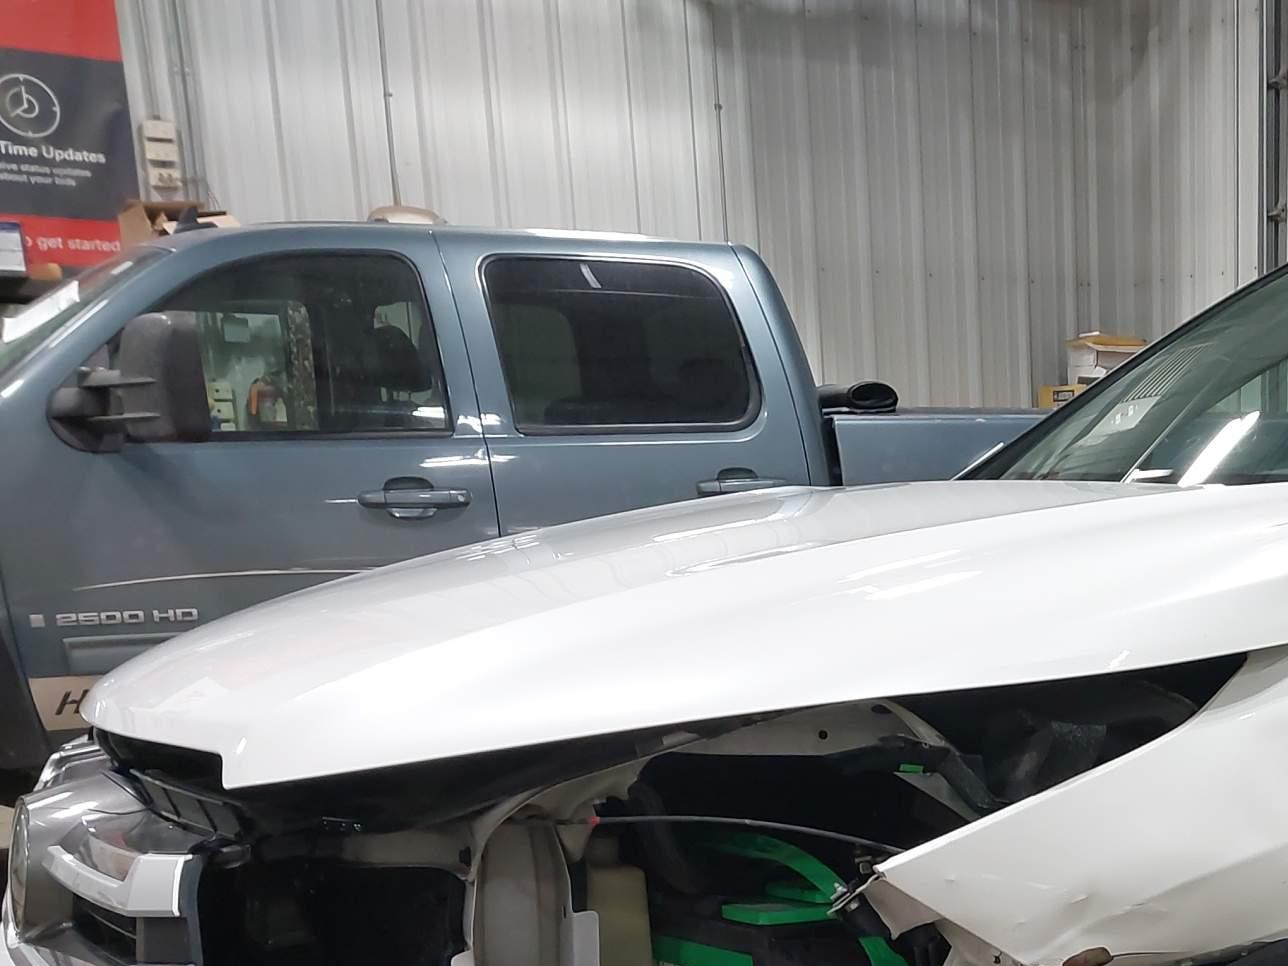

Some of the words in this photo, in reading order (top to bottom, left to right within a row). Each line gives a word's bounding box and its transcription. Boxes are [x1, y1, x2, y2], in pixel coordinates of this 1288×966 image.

[41, 145, 106, 164] Updates
[36, 236, 63, 251] get
[67, 239, 120, 252] started
[55, 611, 145, 626] 2500
[152, 608, 199, 622] HD
